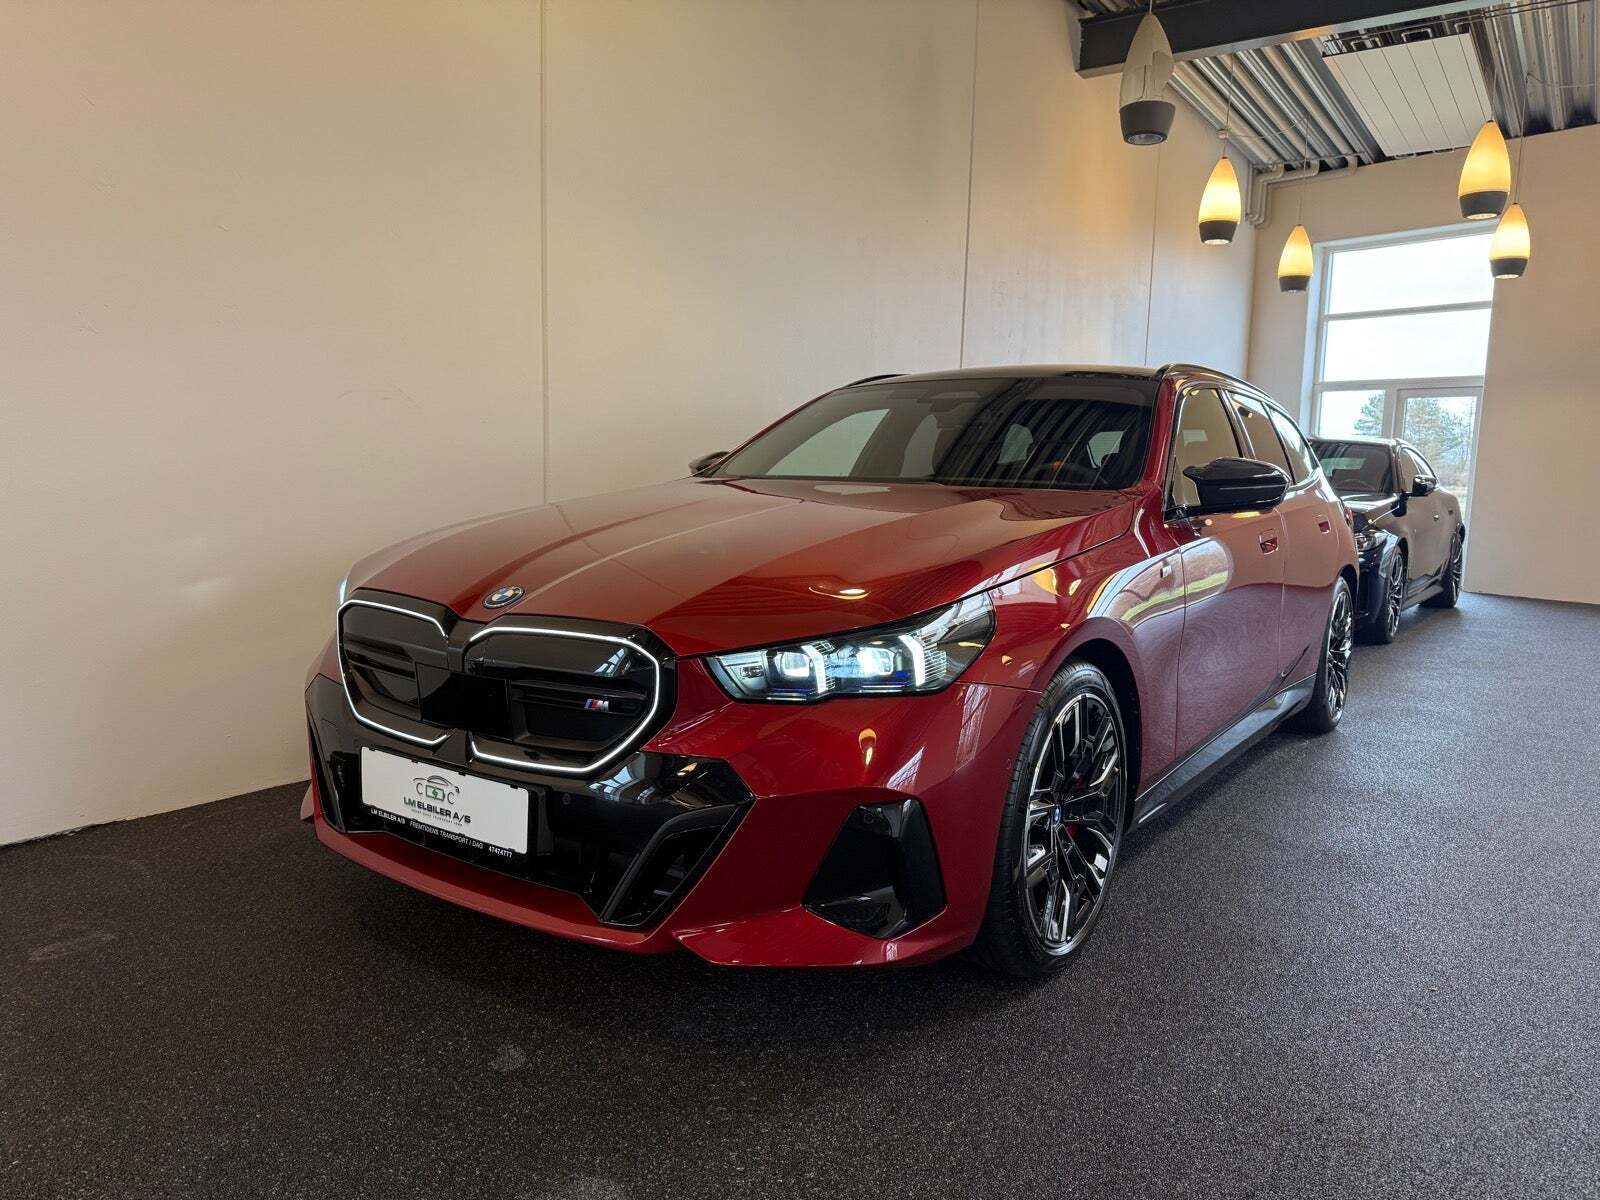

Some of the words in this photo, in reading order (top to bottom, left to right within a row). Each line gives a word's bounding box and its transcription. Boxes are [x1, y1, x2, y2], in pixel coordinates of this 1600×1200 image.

[404, 796, 416, 808] LM
[417, 802, 451, 818] ELBILER
[453, 812, 471, 824] A/S
[378, 811, 397, 821] ELBILER
[410, 820, 439, 835] FREMTIDENS
[440, 831, 468, 844] TRANSPORT
